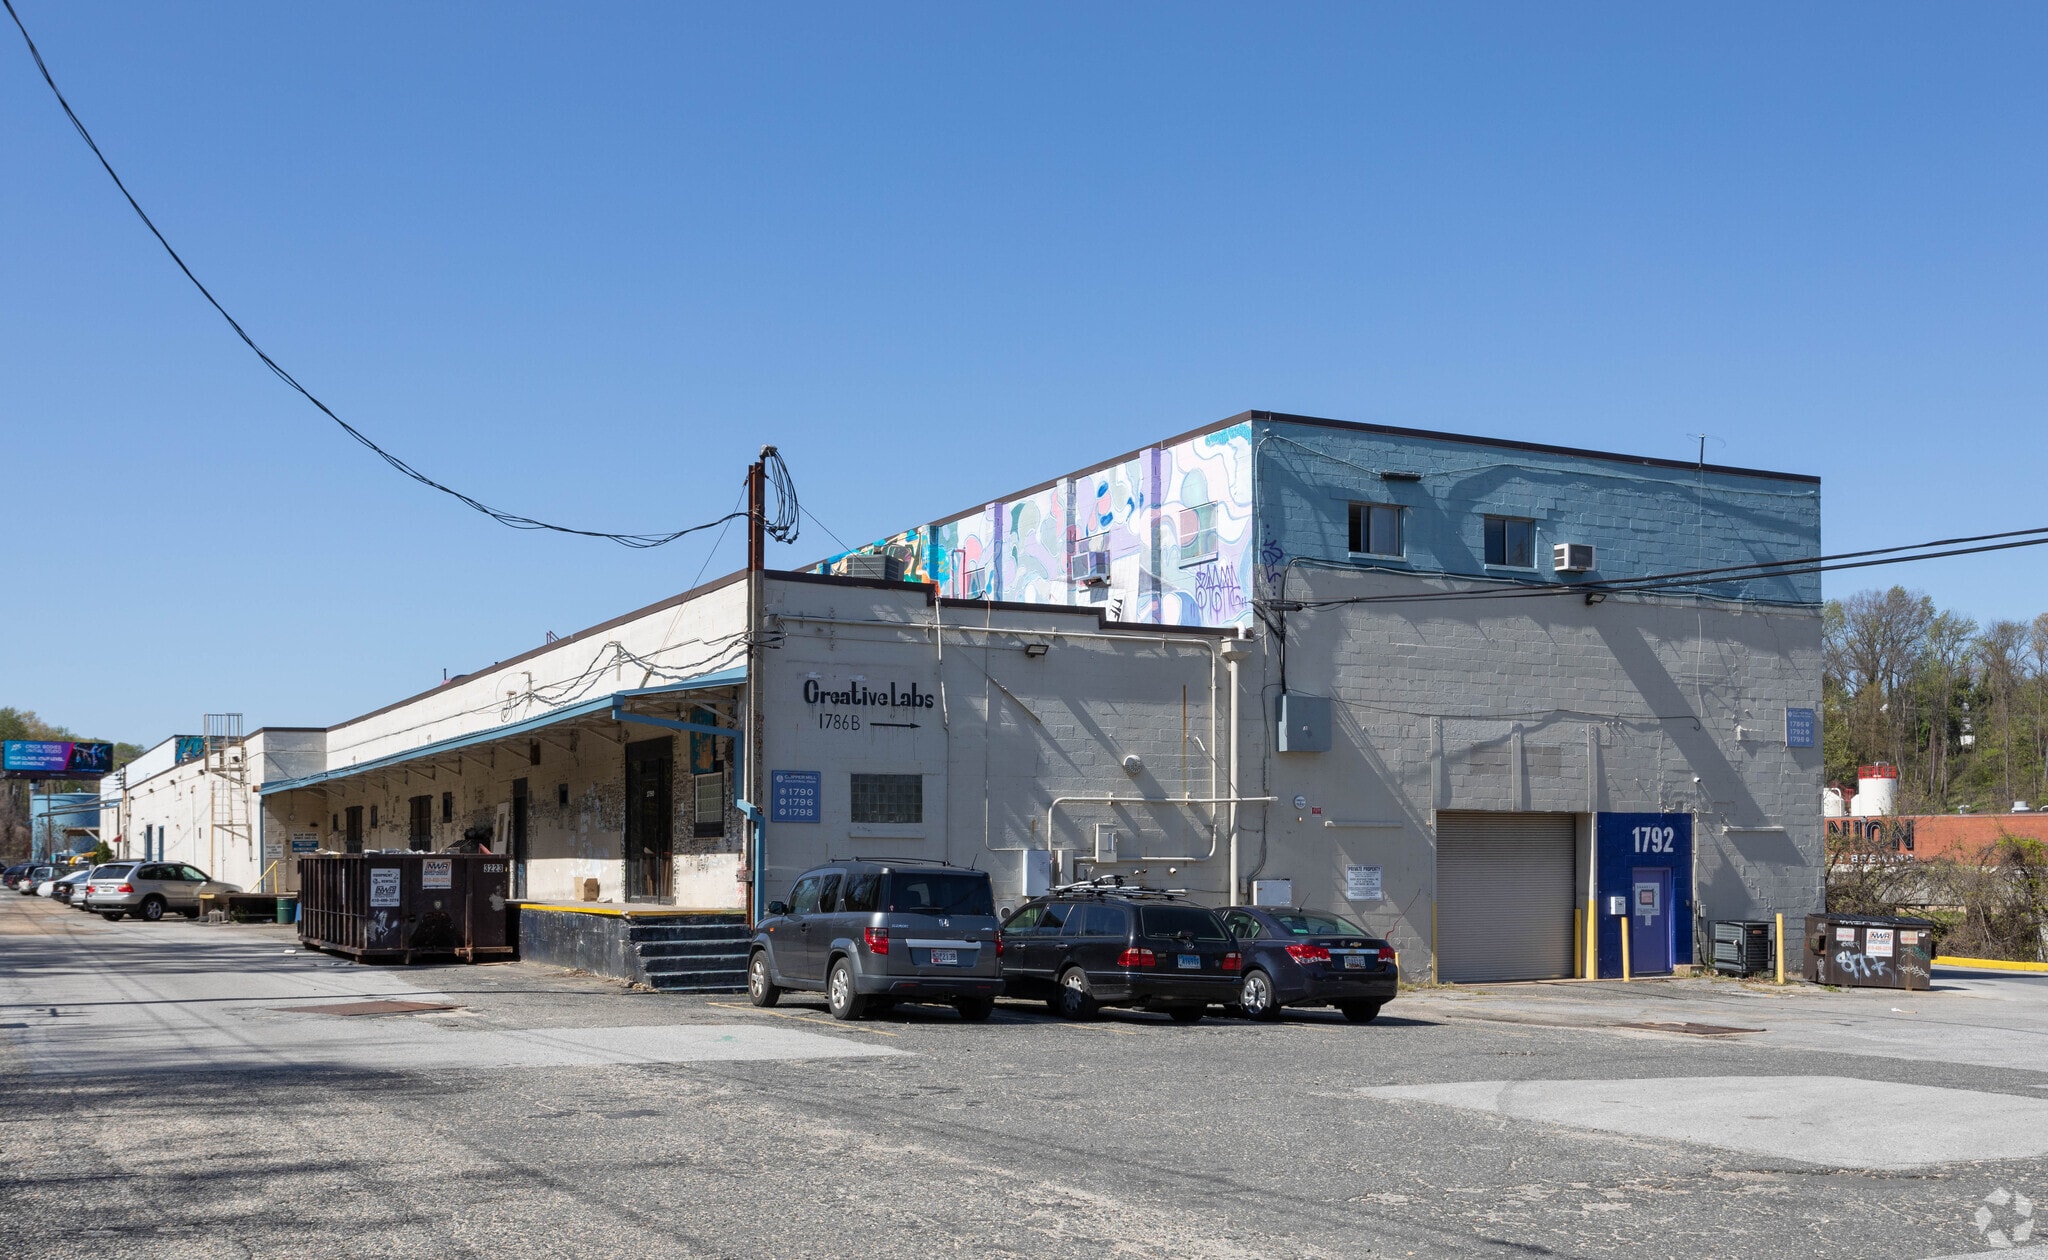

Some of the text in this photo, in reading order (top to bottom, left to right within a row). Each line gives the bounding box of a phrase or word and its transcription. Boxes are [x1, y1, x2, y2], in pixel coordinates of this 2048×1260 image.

[803, 679, 934, 708] Creative Labs
[819, 713, 861, 731] 1786B
[789, 788, 814, 796] 1790
[789, 798, 814, 806] 1796
[789, 808, 813, 817] 1798
[1632, 826, 1674, 853] 1792
[1827, 820, 1914, 851] NION
[483, 864, 504, 873] 3223
